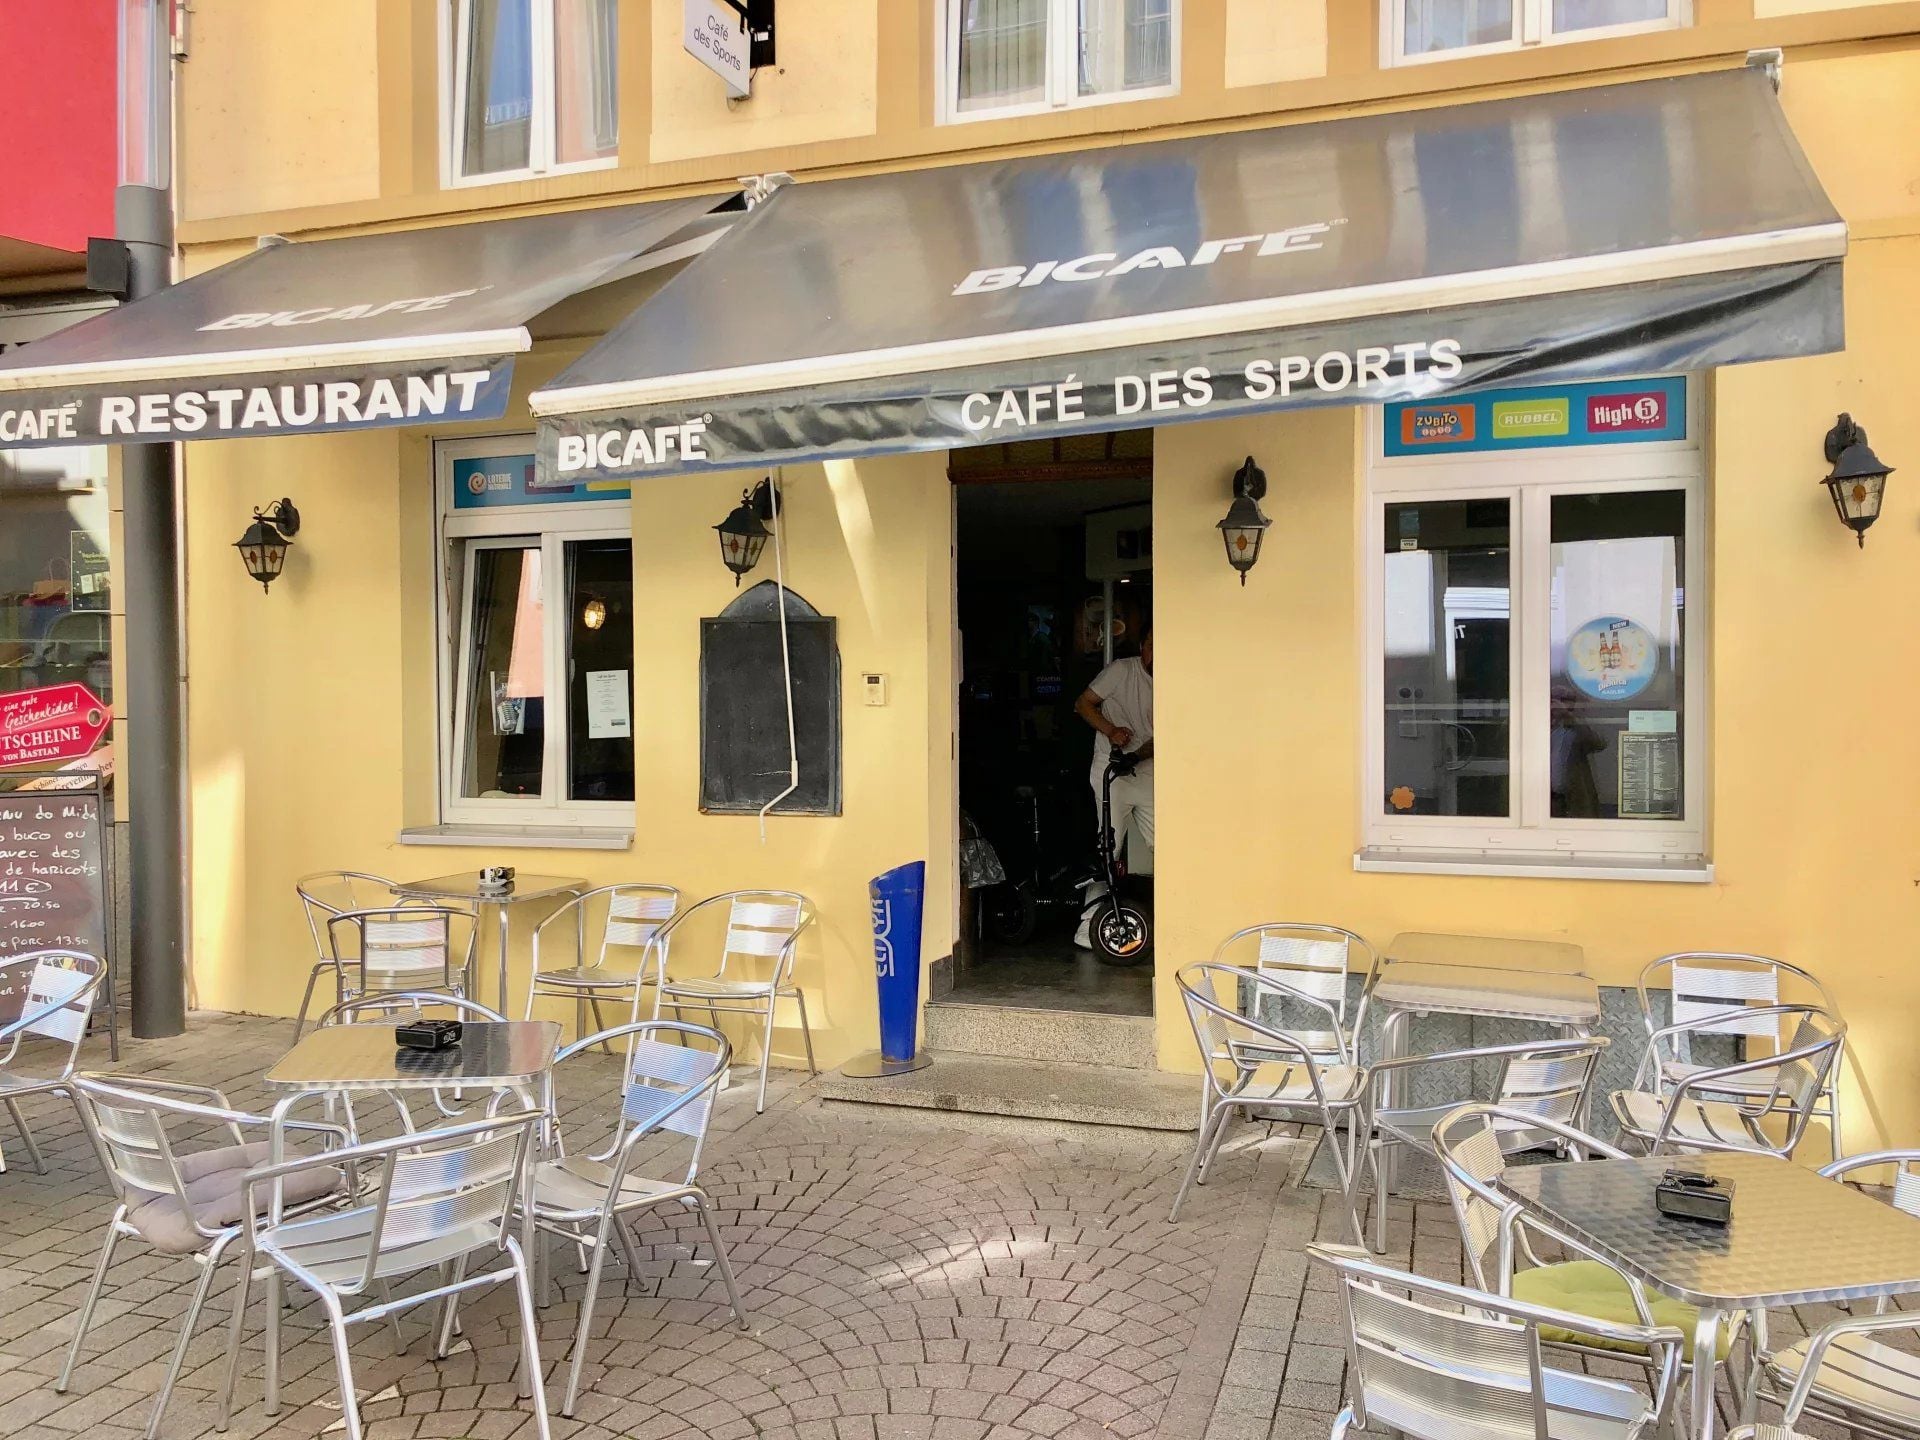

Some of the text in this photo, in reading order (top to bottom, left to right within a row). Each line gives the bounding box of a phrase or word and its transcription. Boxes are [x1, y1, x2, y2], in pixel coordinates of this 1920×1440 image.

[707, 14, 729, 42] Café
[694, 27, 741, 71] des Sports
[961, 338, 1464, 431] CAFÉ DES SPORTS
[100, 370, 491, 435] RESTAURANT
[1416, 412, 1458, 427] ZUBITO
[1594, 403, 1633, 426] High
[1612, 621, 1627, 630] NEW
[3, 694, 38, 713] eine gute
[0, 726, 81, 750] TSCHEINE
[13, 827, 51, 841] buco
[52, 845, 81, 859] des
[6, 862, 23, 875] de
[23, 901, 60, 910] 20.50
[56, 936, 89, 946] 13.50
